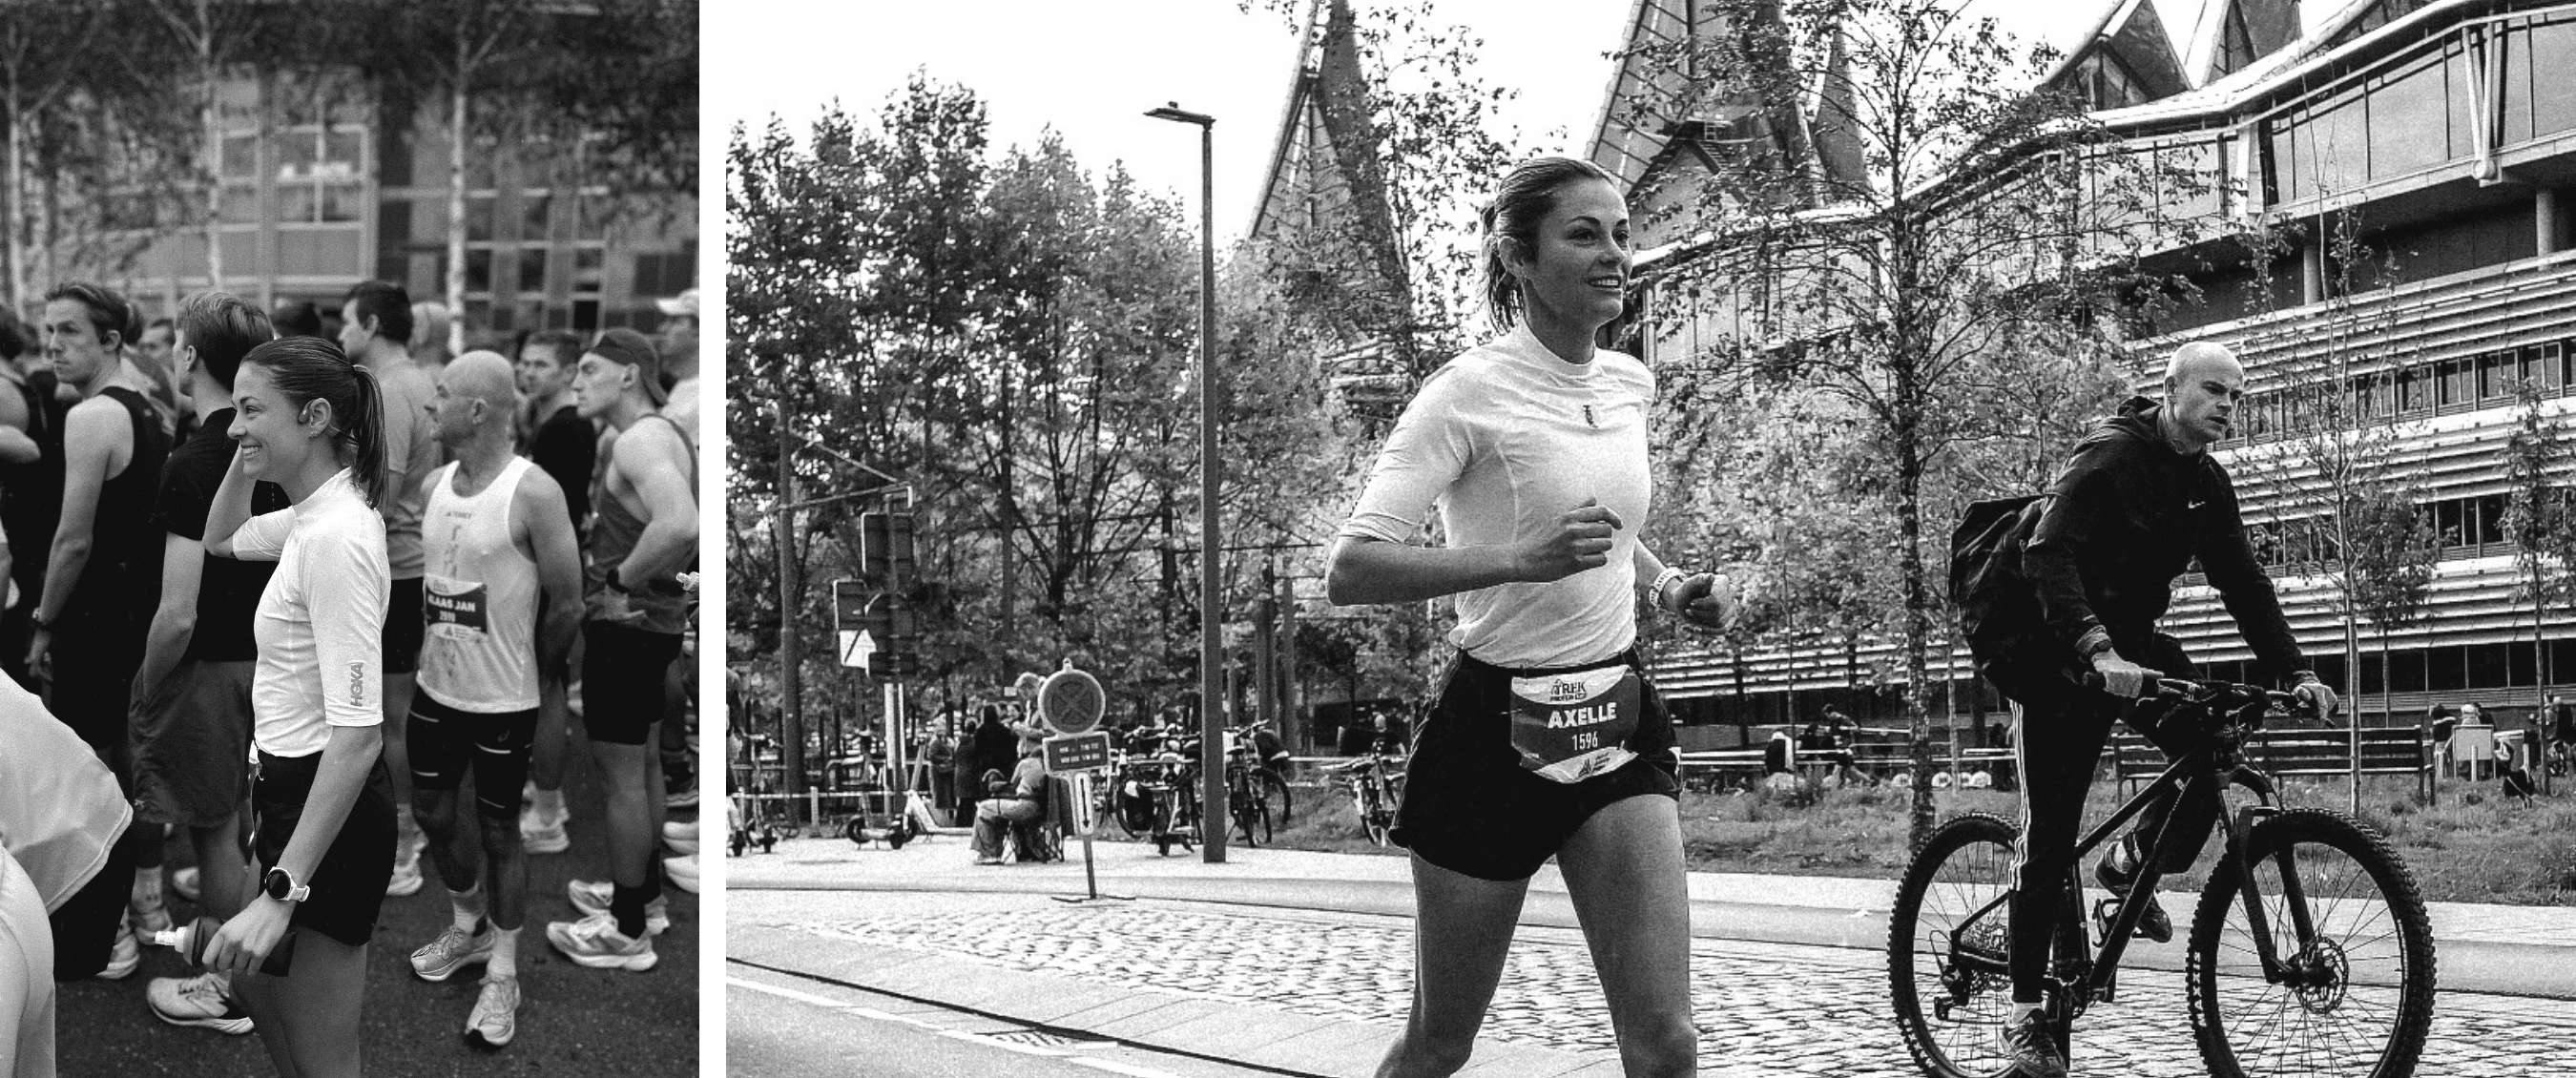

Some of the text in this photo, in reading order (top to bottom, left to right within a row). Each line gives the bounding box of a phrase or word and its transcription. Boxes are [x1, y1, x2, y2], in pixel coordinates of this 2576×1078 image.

[350, 662, 364, 707] HOKA
[1548, 702, 1617, 729] AXELLE
[1572, 731, 1598, 751] 1596
[2192, 951, 2208, 1027] MAXXIS
